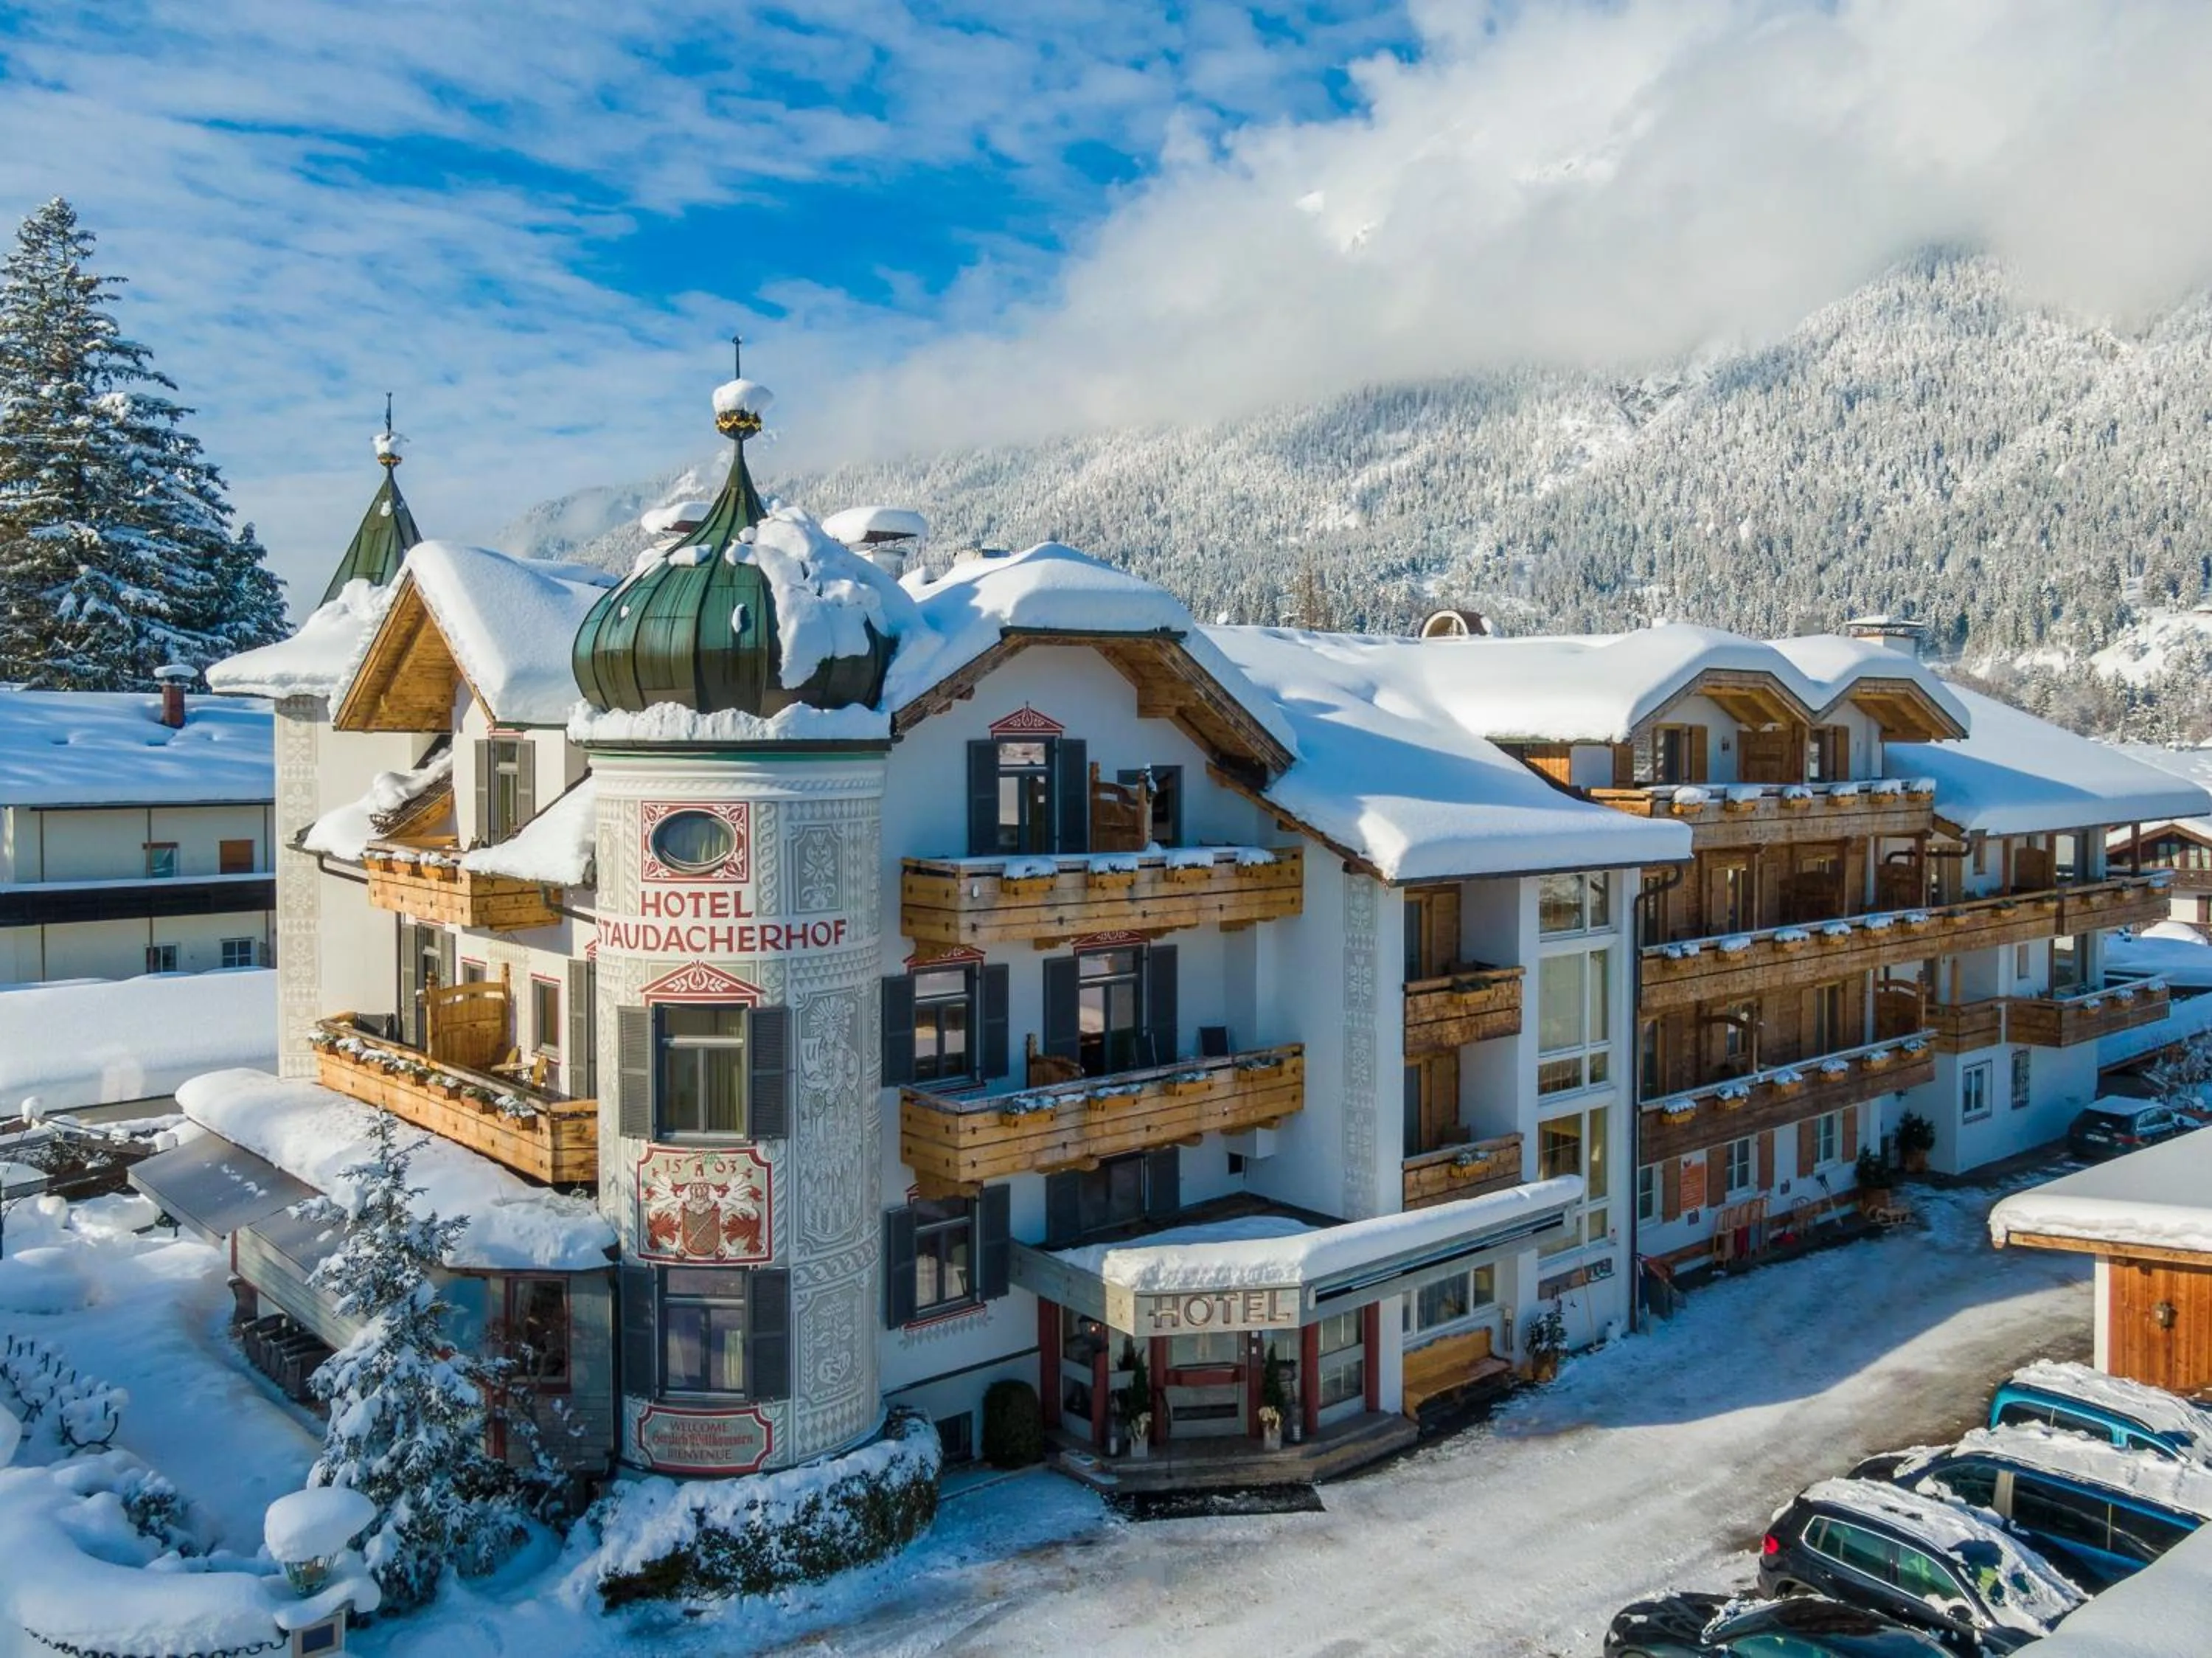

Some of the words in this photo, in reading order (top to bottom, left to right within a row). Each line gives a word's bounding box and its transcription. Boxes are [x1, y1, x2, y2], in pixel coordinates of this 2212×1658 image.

[640, 890, 754, 918] HOTEL
[597, 918, 847, 953] STAUDACHERHOF
[1147, 1291, 1291, 1328] HOTEL
[670, 1421, 731, 1432] WELCOME
